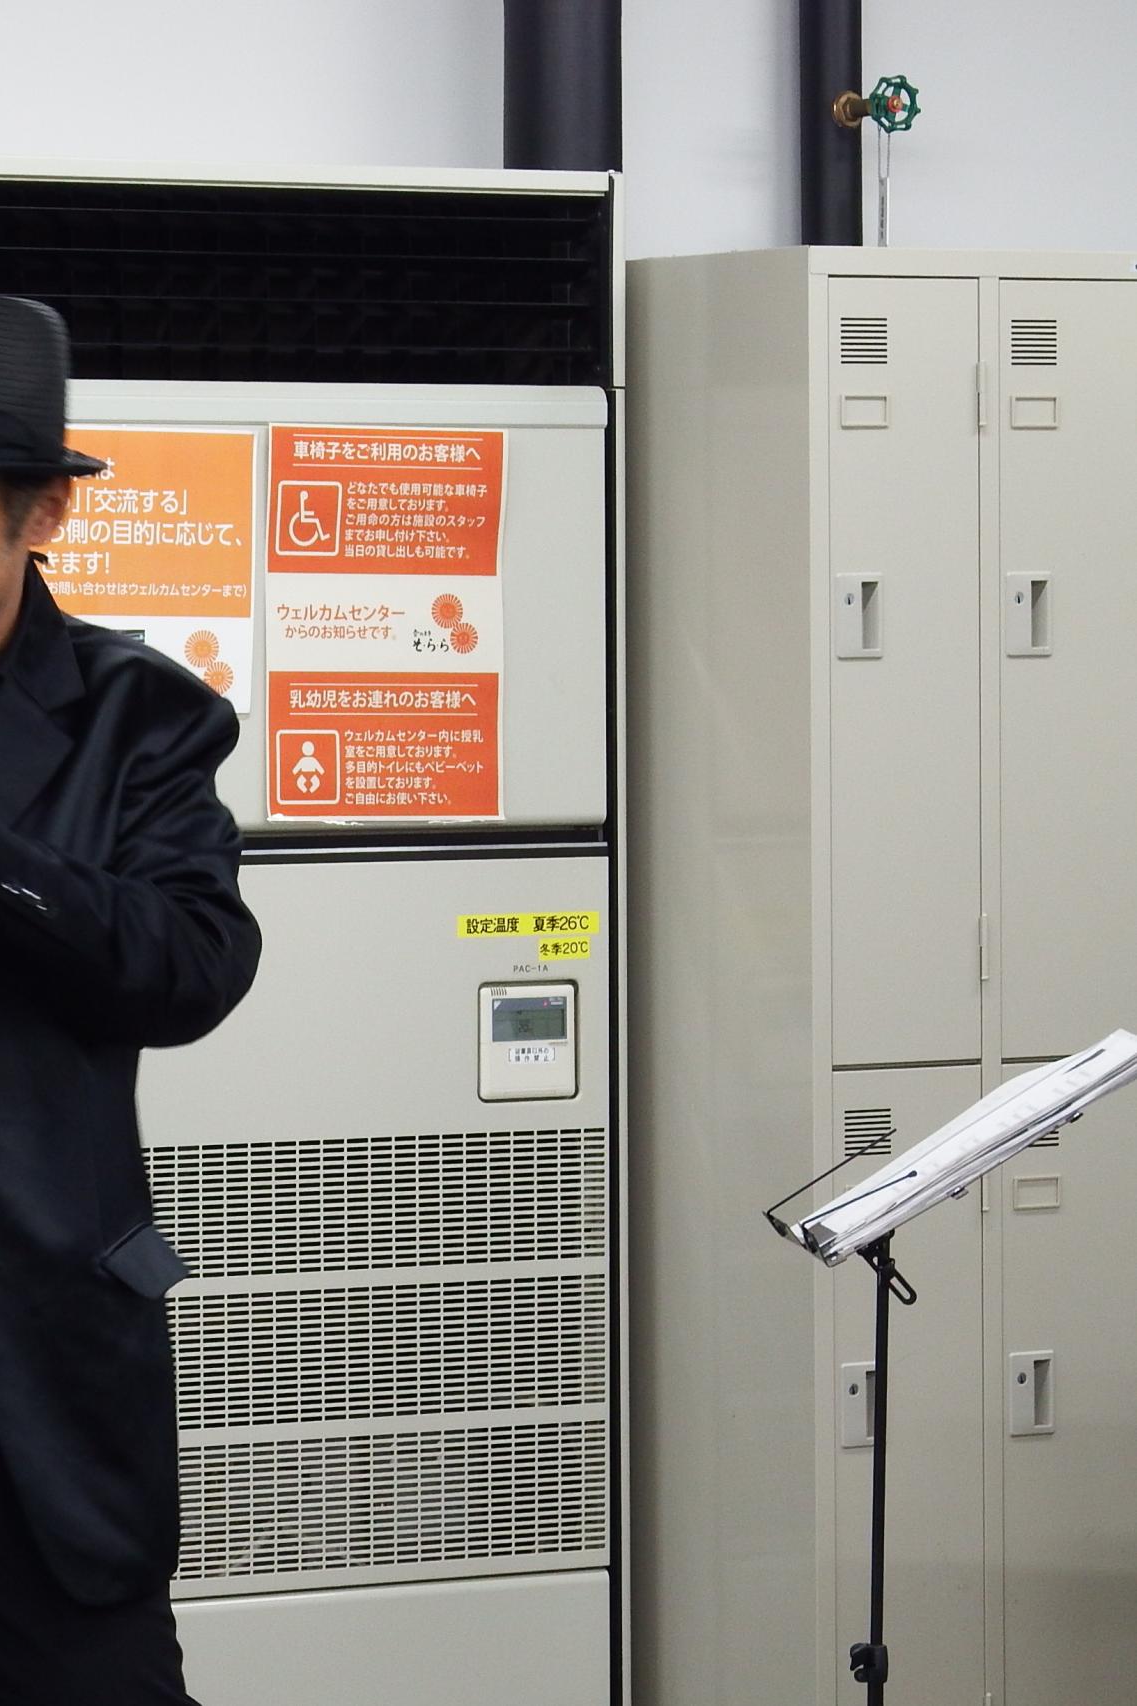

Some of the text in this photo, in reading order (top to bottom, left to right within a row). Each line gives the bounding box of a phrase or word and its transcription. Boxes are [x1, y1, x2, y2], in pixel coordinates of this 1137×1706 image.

[293, 441, 481, 463] 車椅子をご利用のお客様へ
[347, 481, 488, 498] どなたでも使用可能な車椅子
[66, 487, 188, 515] 」「交流する」
[347, 497, 450, 512] をご用意しております。
[345, 512, 486, 528] ご用命の方は施設のスタッフ
[344, 528, 451, 544] までお申し付け下さい。
[344, 543, 471, 560] 当日の貸し出しも可能です。
[276, 603, 405, 622] ウェルカムセンター
[285, 625, 397, 641] からのお知らせです。
[289, 689, 477, 709] 乳幼児をお連れのお客様へ
[344, 729, 484, 743] ウェルカムセンター内に授乳
[344, 744, 457, 759] 室をご用意しております。
[345, 775, 437, 790] を設置しております。
[344, 791, 452, 806] ご自由にお使い下さい。
[466, 917, 520, 934] 設定温度
